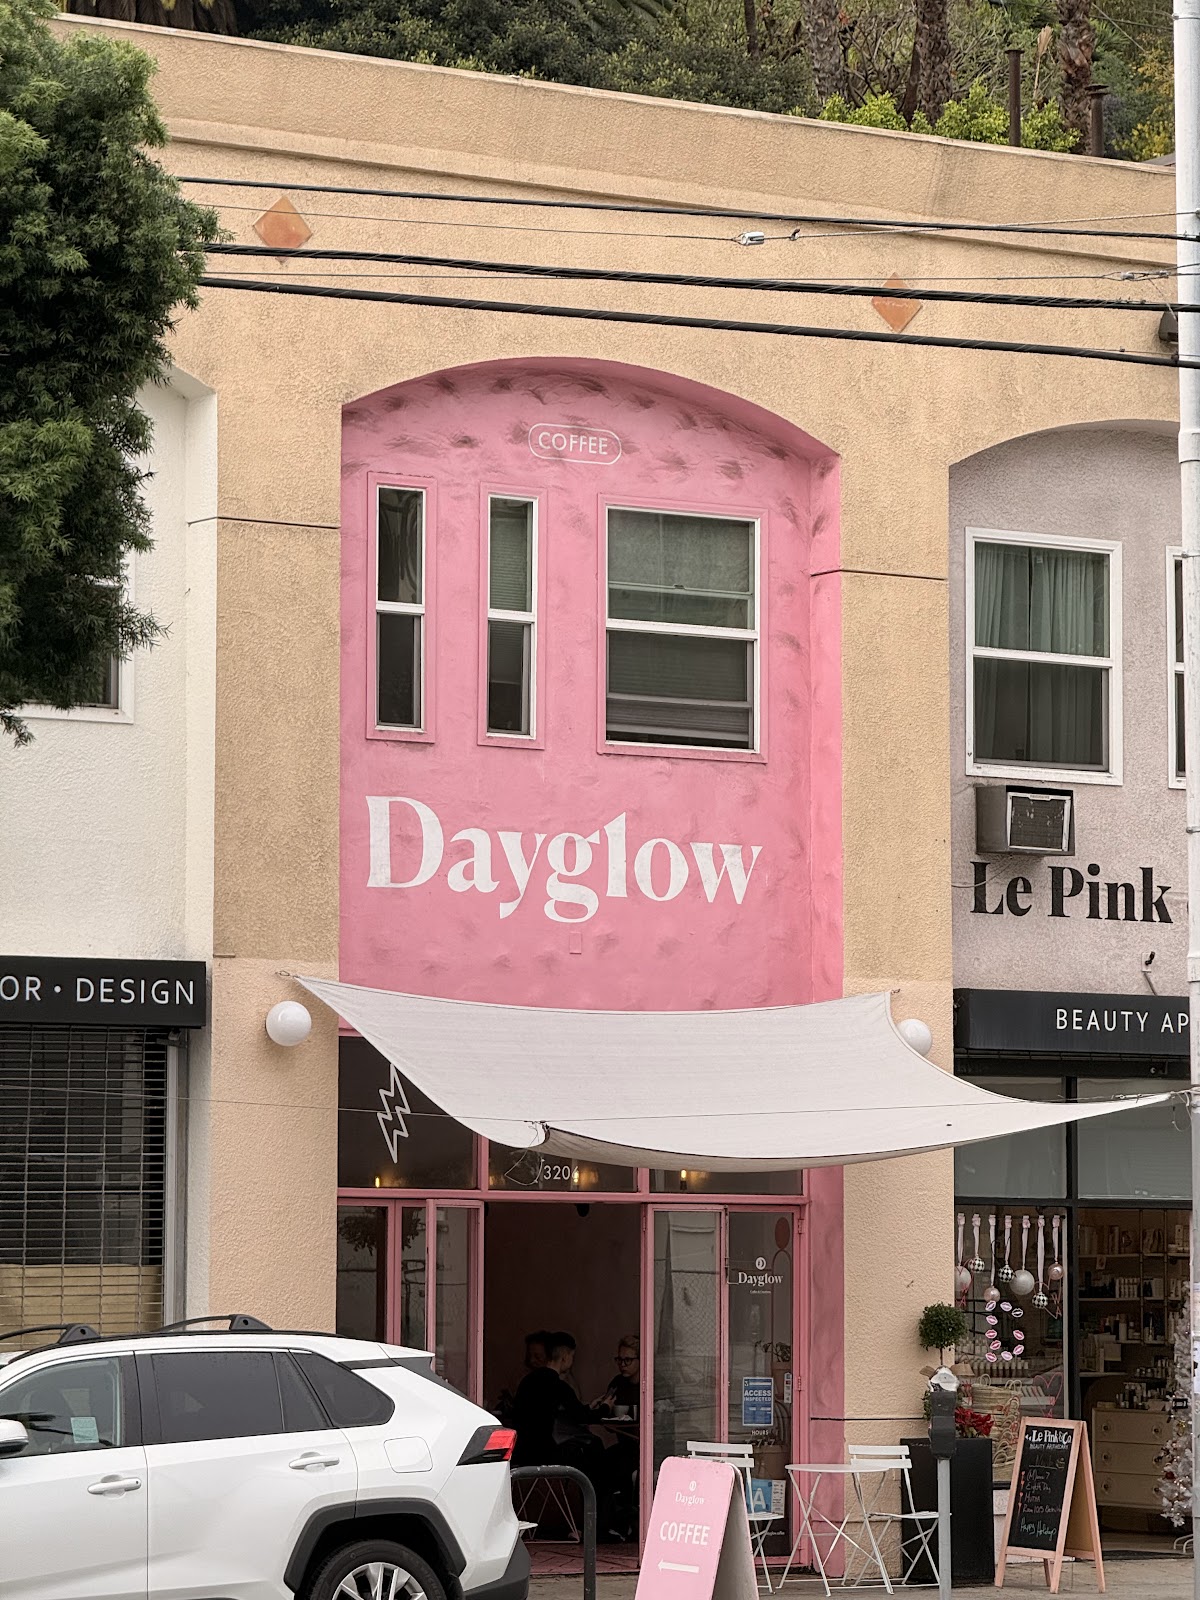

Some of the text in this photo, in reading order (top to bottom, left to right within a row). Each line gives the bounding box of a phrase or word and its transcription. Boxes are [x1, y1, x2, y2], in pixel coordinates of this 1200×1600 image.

[538, 431, 608, 455] COFFEE
[365, 795, 763, 923] Dayglow
[970, 861, 1173, 923] Le Pink
[0, 975, 194, 1005] OR DESIGN
[1056, 1008, 1189, 1034] BEAUTY AP
[738, 1271, 783, 1287] Dayglow
[1031, 1429, 1043, 1442] Le
[675, 1491, 705, 1506] Dayglow
[753, 1487, 767, 1510] A
[660, 1520, 711, 1546] COFFEE
